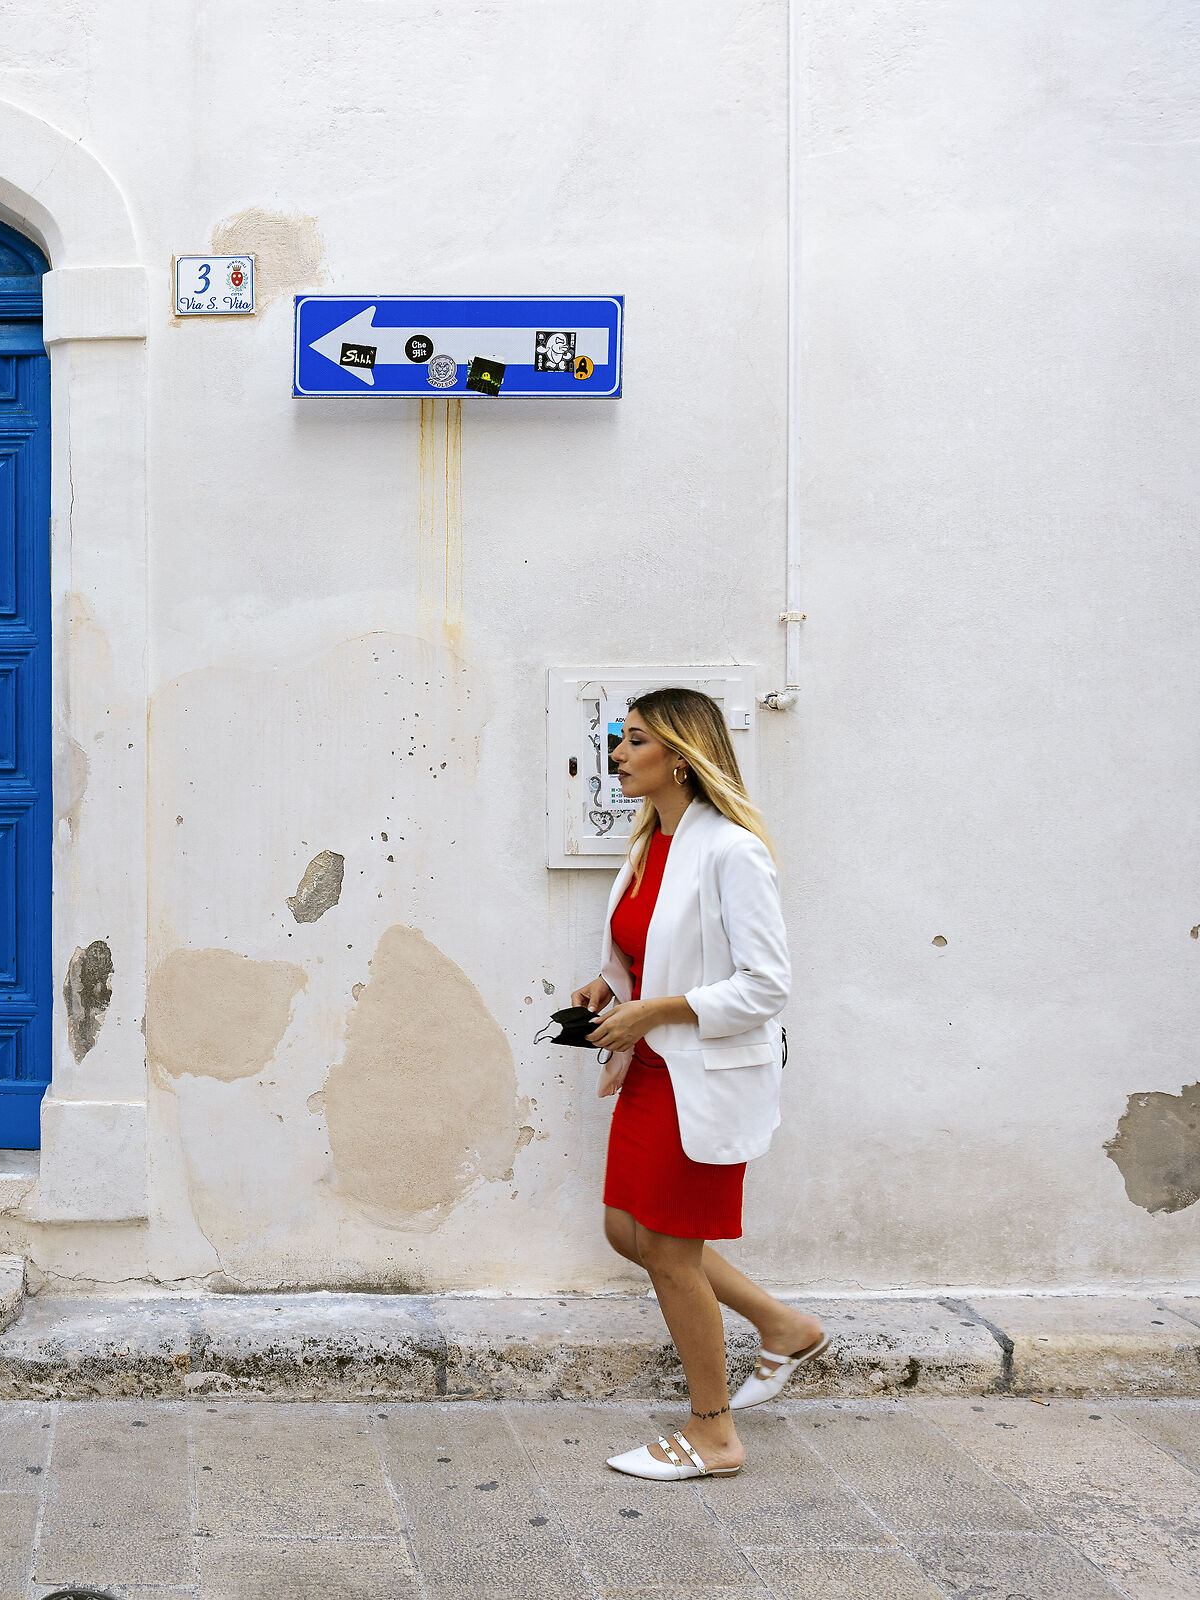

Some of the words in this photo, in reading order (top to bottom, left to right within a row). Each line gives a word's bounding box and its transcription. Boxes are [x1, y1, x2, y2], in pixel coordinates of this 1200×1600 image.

[193, 264, 211, 294] 3
[180, 297, 204, 310] Via
[206, 296, 218, 310] S.
[222, 296, 251, 310] Vito
